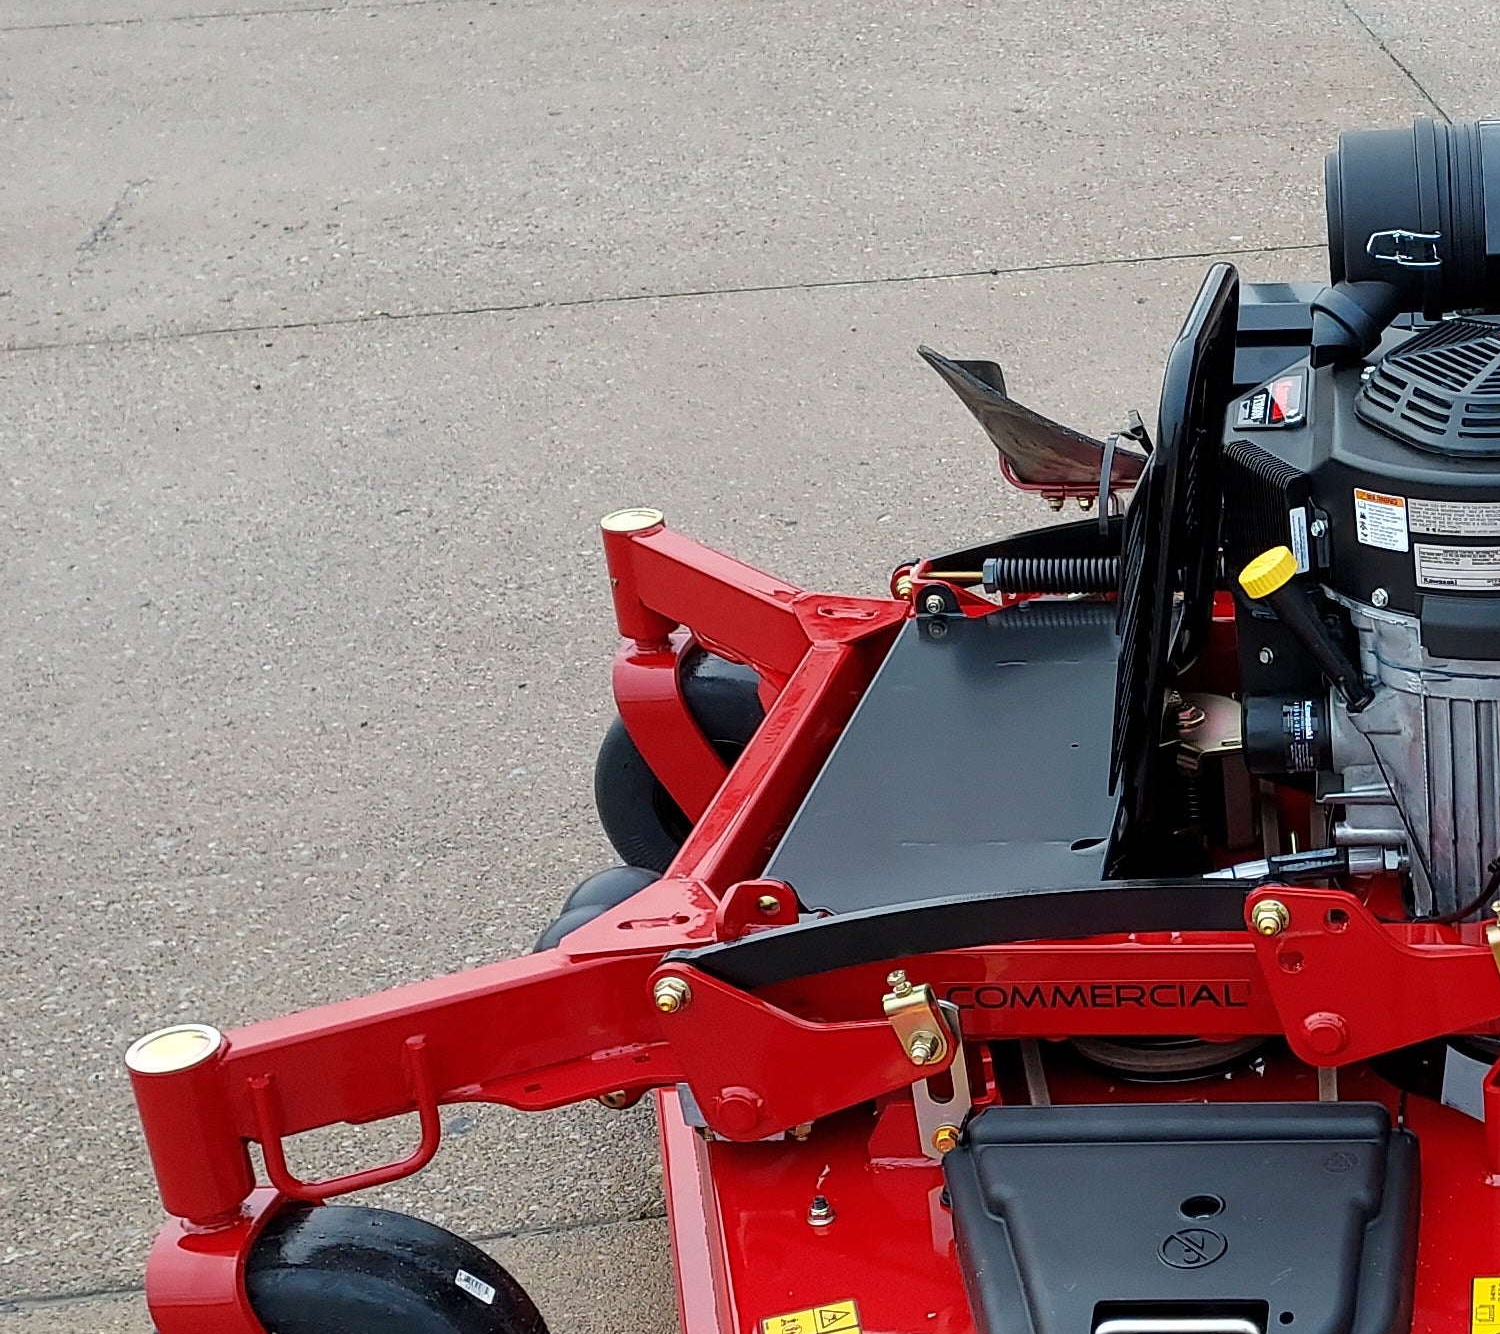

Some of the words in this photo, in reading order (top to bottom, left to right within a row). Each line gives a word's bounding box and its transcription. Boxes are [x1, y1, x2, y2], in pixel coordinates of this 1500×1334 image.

[1422, 577, 1458, 586] Kawasaki
[1304, 700, 1314, 740] Kawasaki
[947, 982, 1249, 1010] COMMERCIAL
